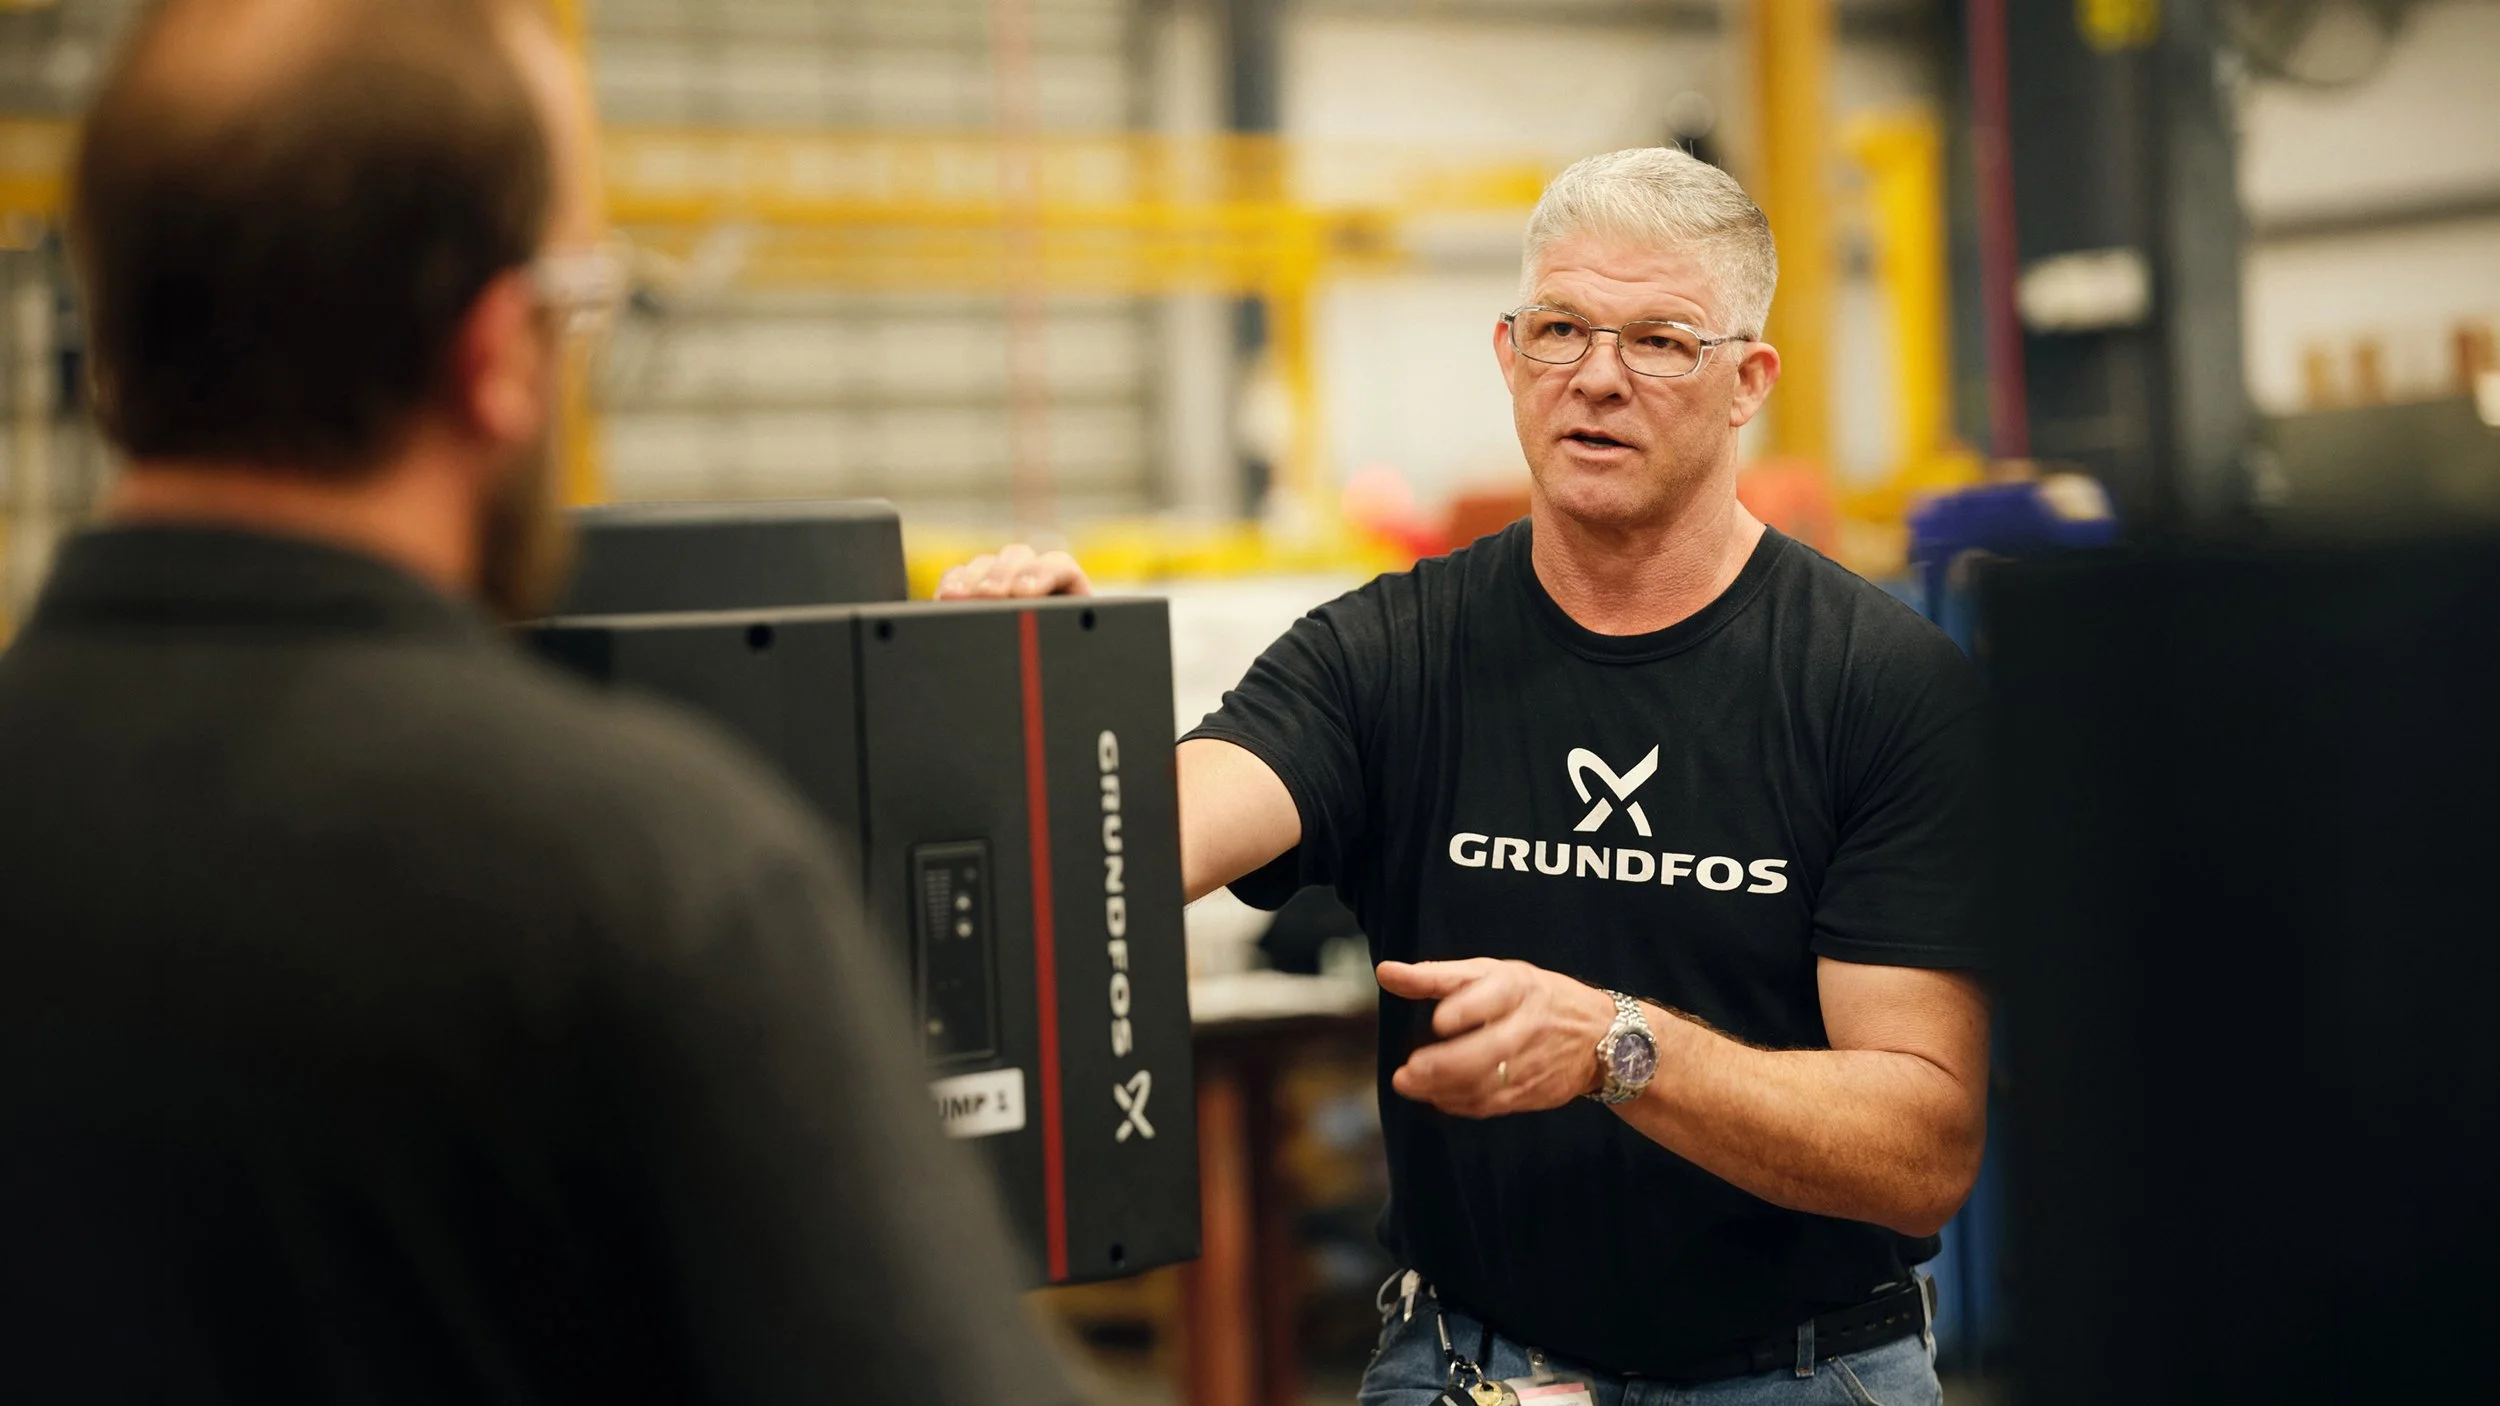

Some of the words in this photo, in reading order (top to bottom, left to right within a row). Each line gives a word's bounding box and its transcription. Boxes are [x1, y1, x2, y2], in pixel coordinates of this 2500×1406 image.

[1098, 730, 1133, 1057] GRUNDFOS
[1448, 832, 1788, 894] GRUNDFOS
[937, 1092, 989, 1120] UMP
